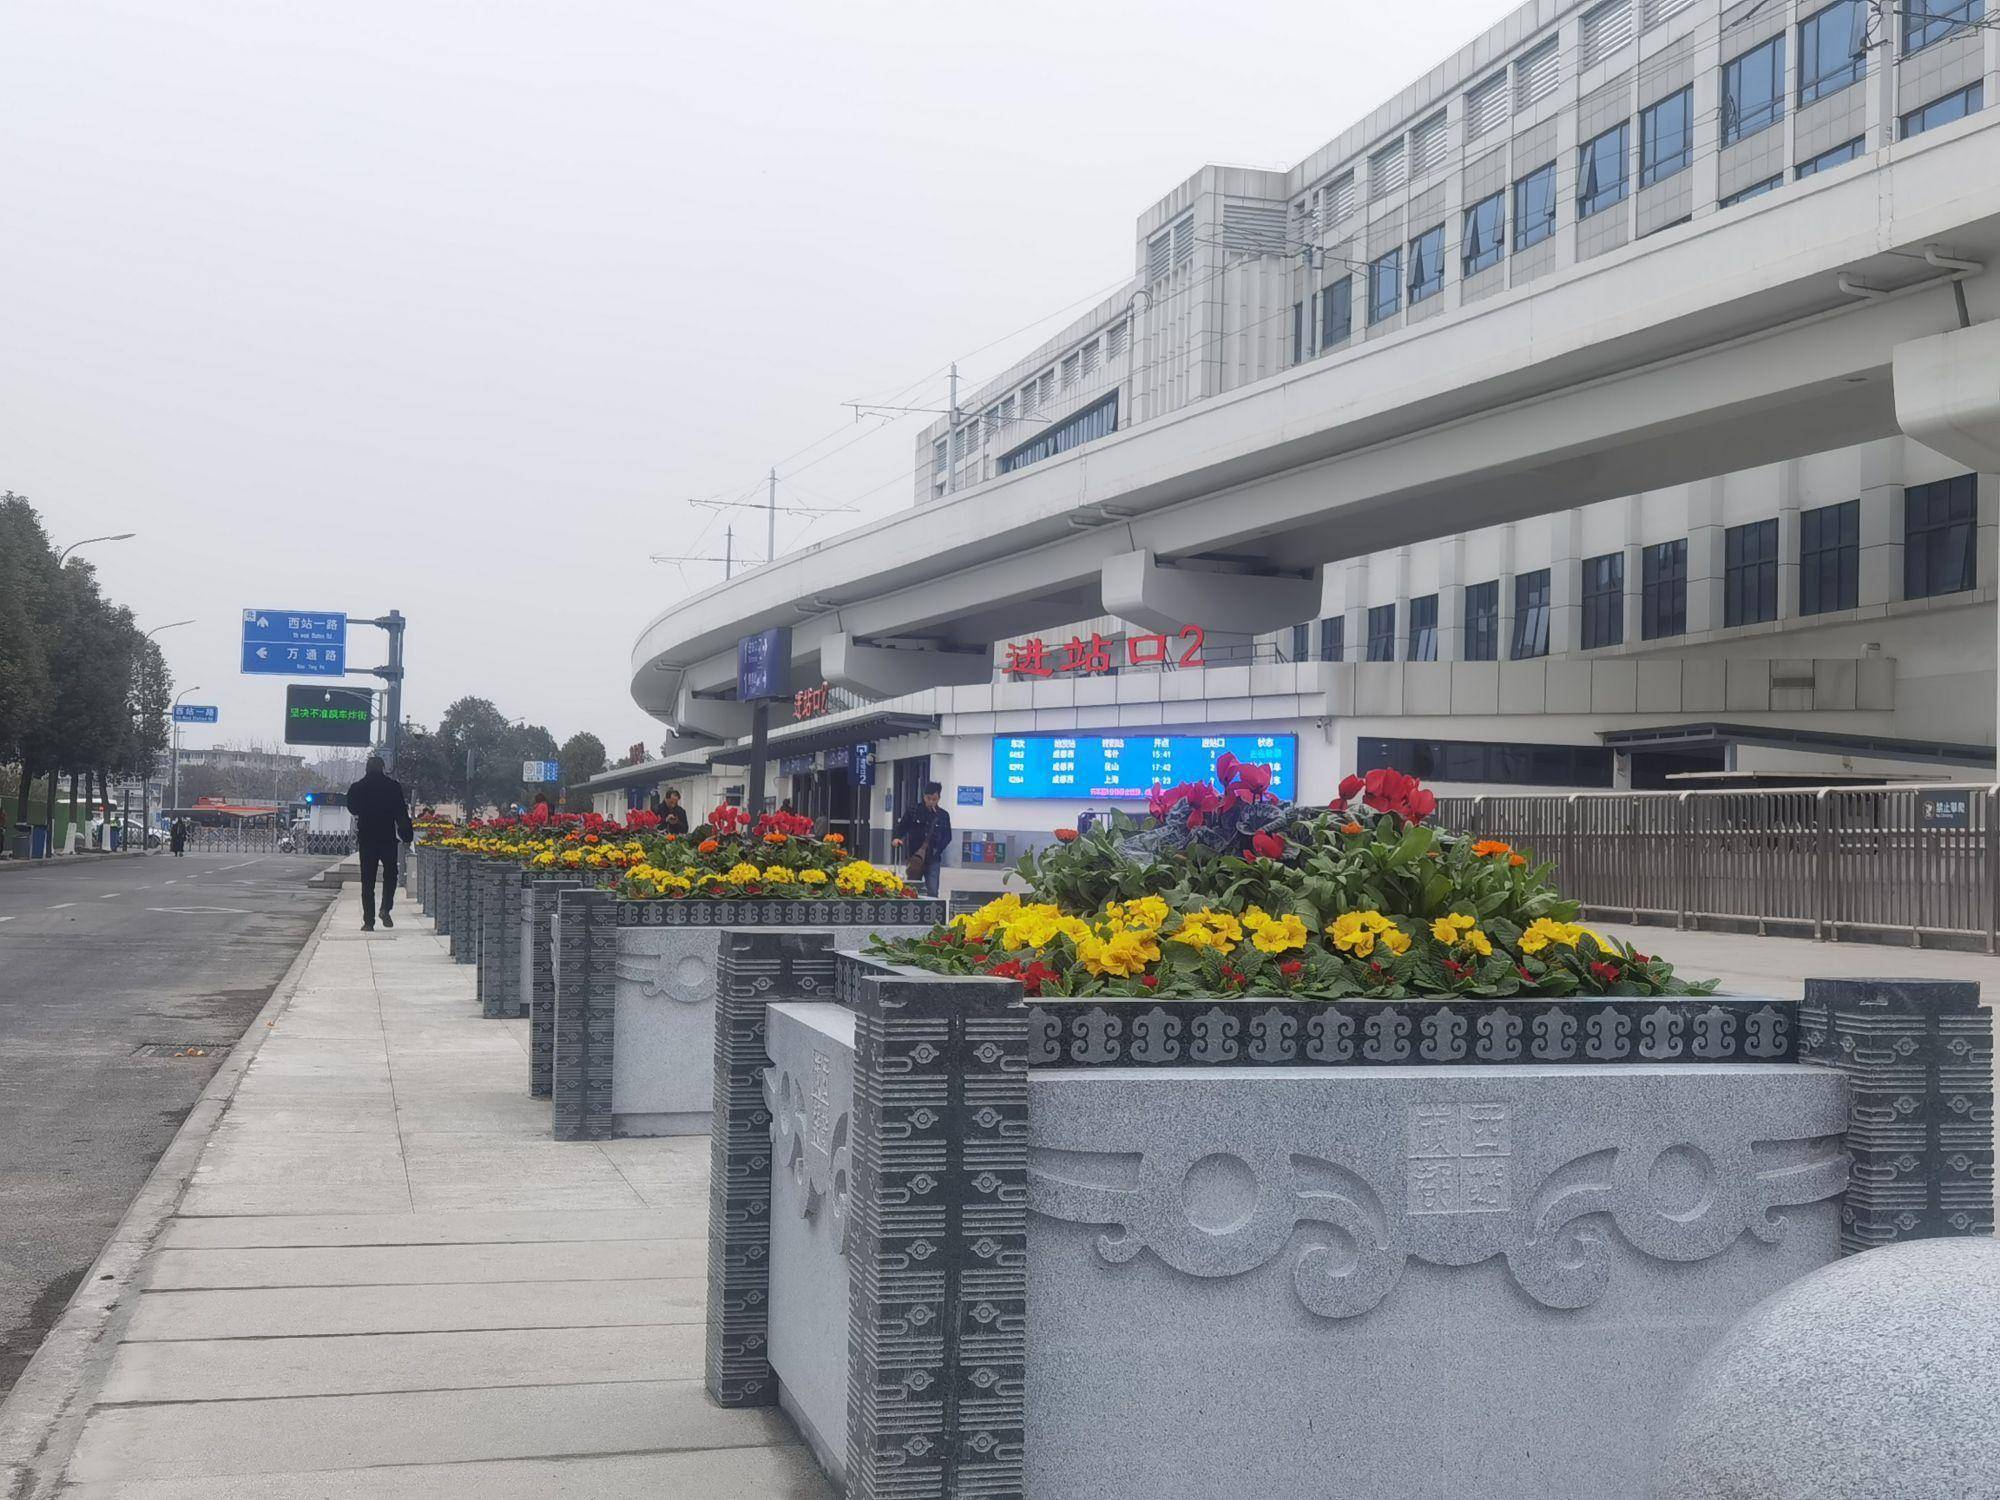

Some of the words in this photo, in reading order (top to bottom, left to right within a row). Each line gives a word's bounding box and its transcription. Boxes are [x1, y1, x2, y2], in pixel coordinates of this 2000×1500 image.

[288, 616, 338, 631] 西站一路
[287, 648, 337, 662] 万通路
[1002, 624, 1205, 677] 进站口2
[175, 707, 215, 717] 西站一路
[1152, 750, 1171, 759] 15:41
[1210, 750, 1216, 759] 2
[1104, 775, 1120, 785] 上海
[1935, 801, 1966, 814] 禁止攀爬
